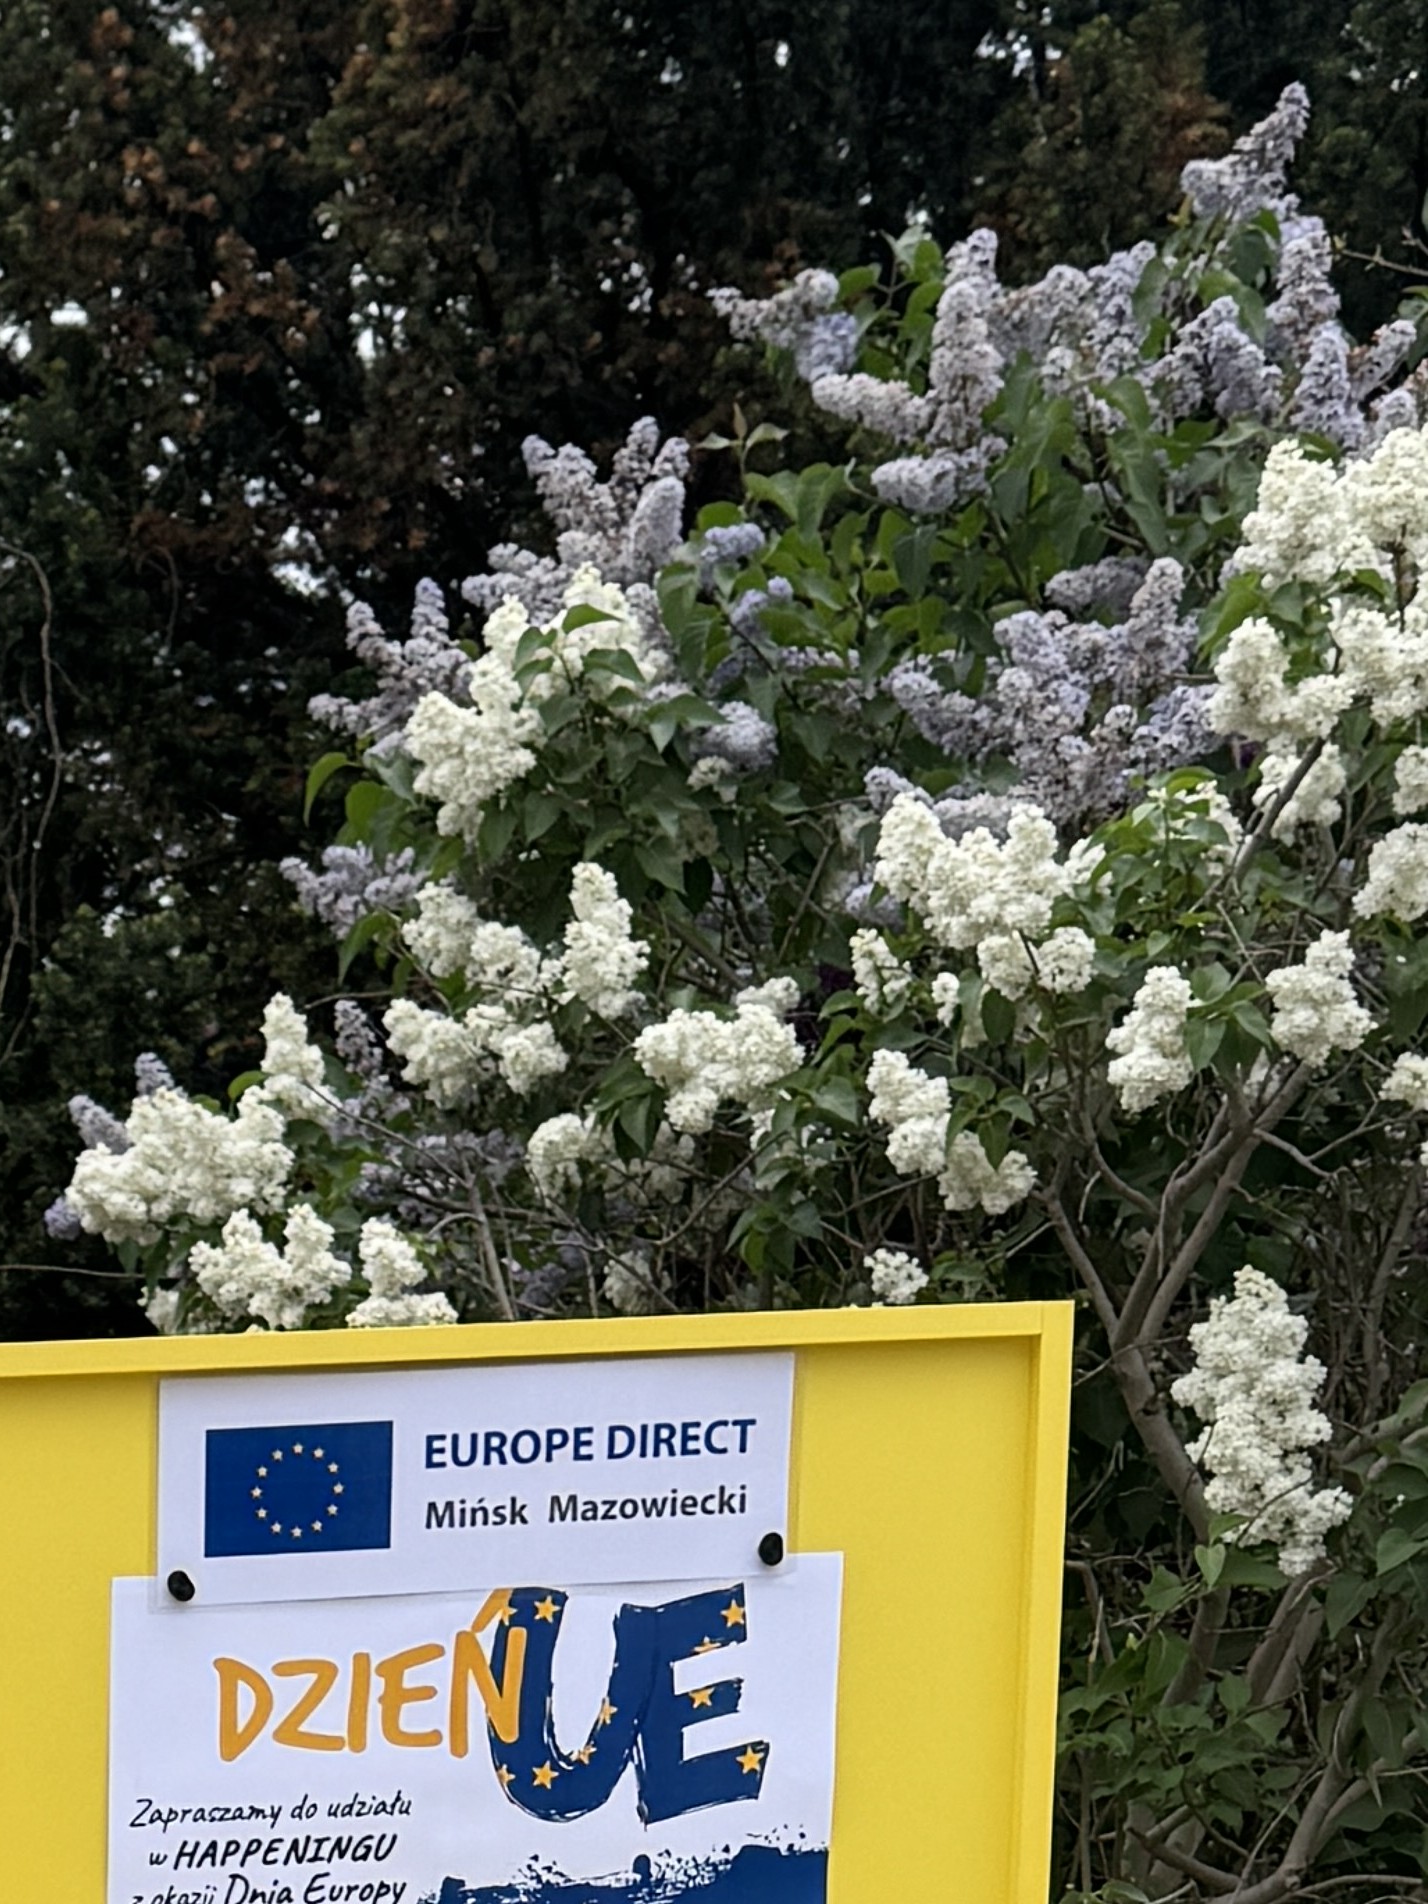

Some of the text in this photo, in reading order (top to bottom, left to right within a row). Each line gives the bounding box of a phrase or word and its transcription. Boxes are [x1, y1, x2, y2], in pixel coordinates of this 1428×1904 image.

[425, 1419, 757, 1469] EUROPE DIRECT
[425, 1485, 747, 1529] Mińsk Mazowiecki
[213, 1582, 770, 1829] DZIEŃ UE
[129, 1790, 412, 1833] Zapraszamy do udziału
[149, 1834, 398, 1870] w HAPPENINGU
